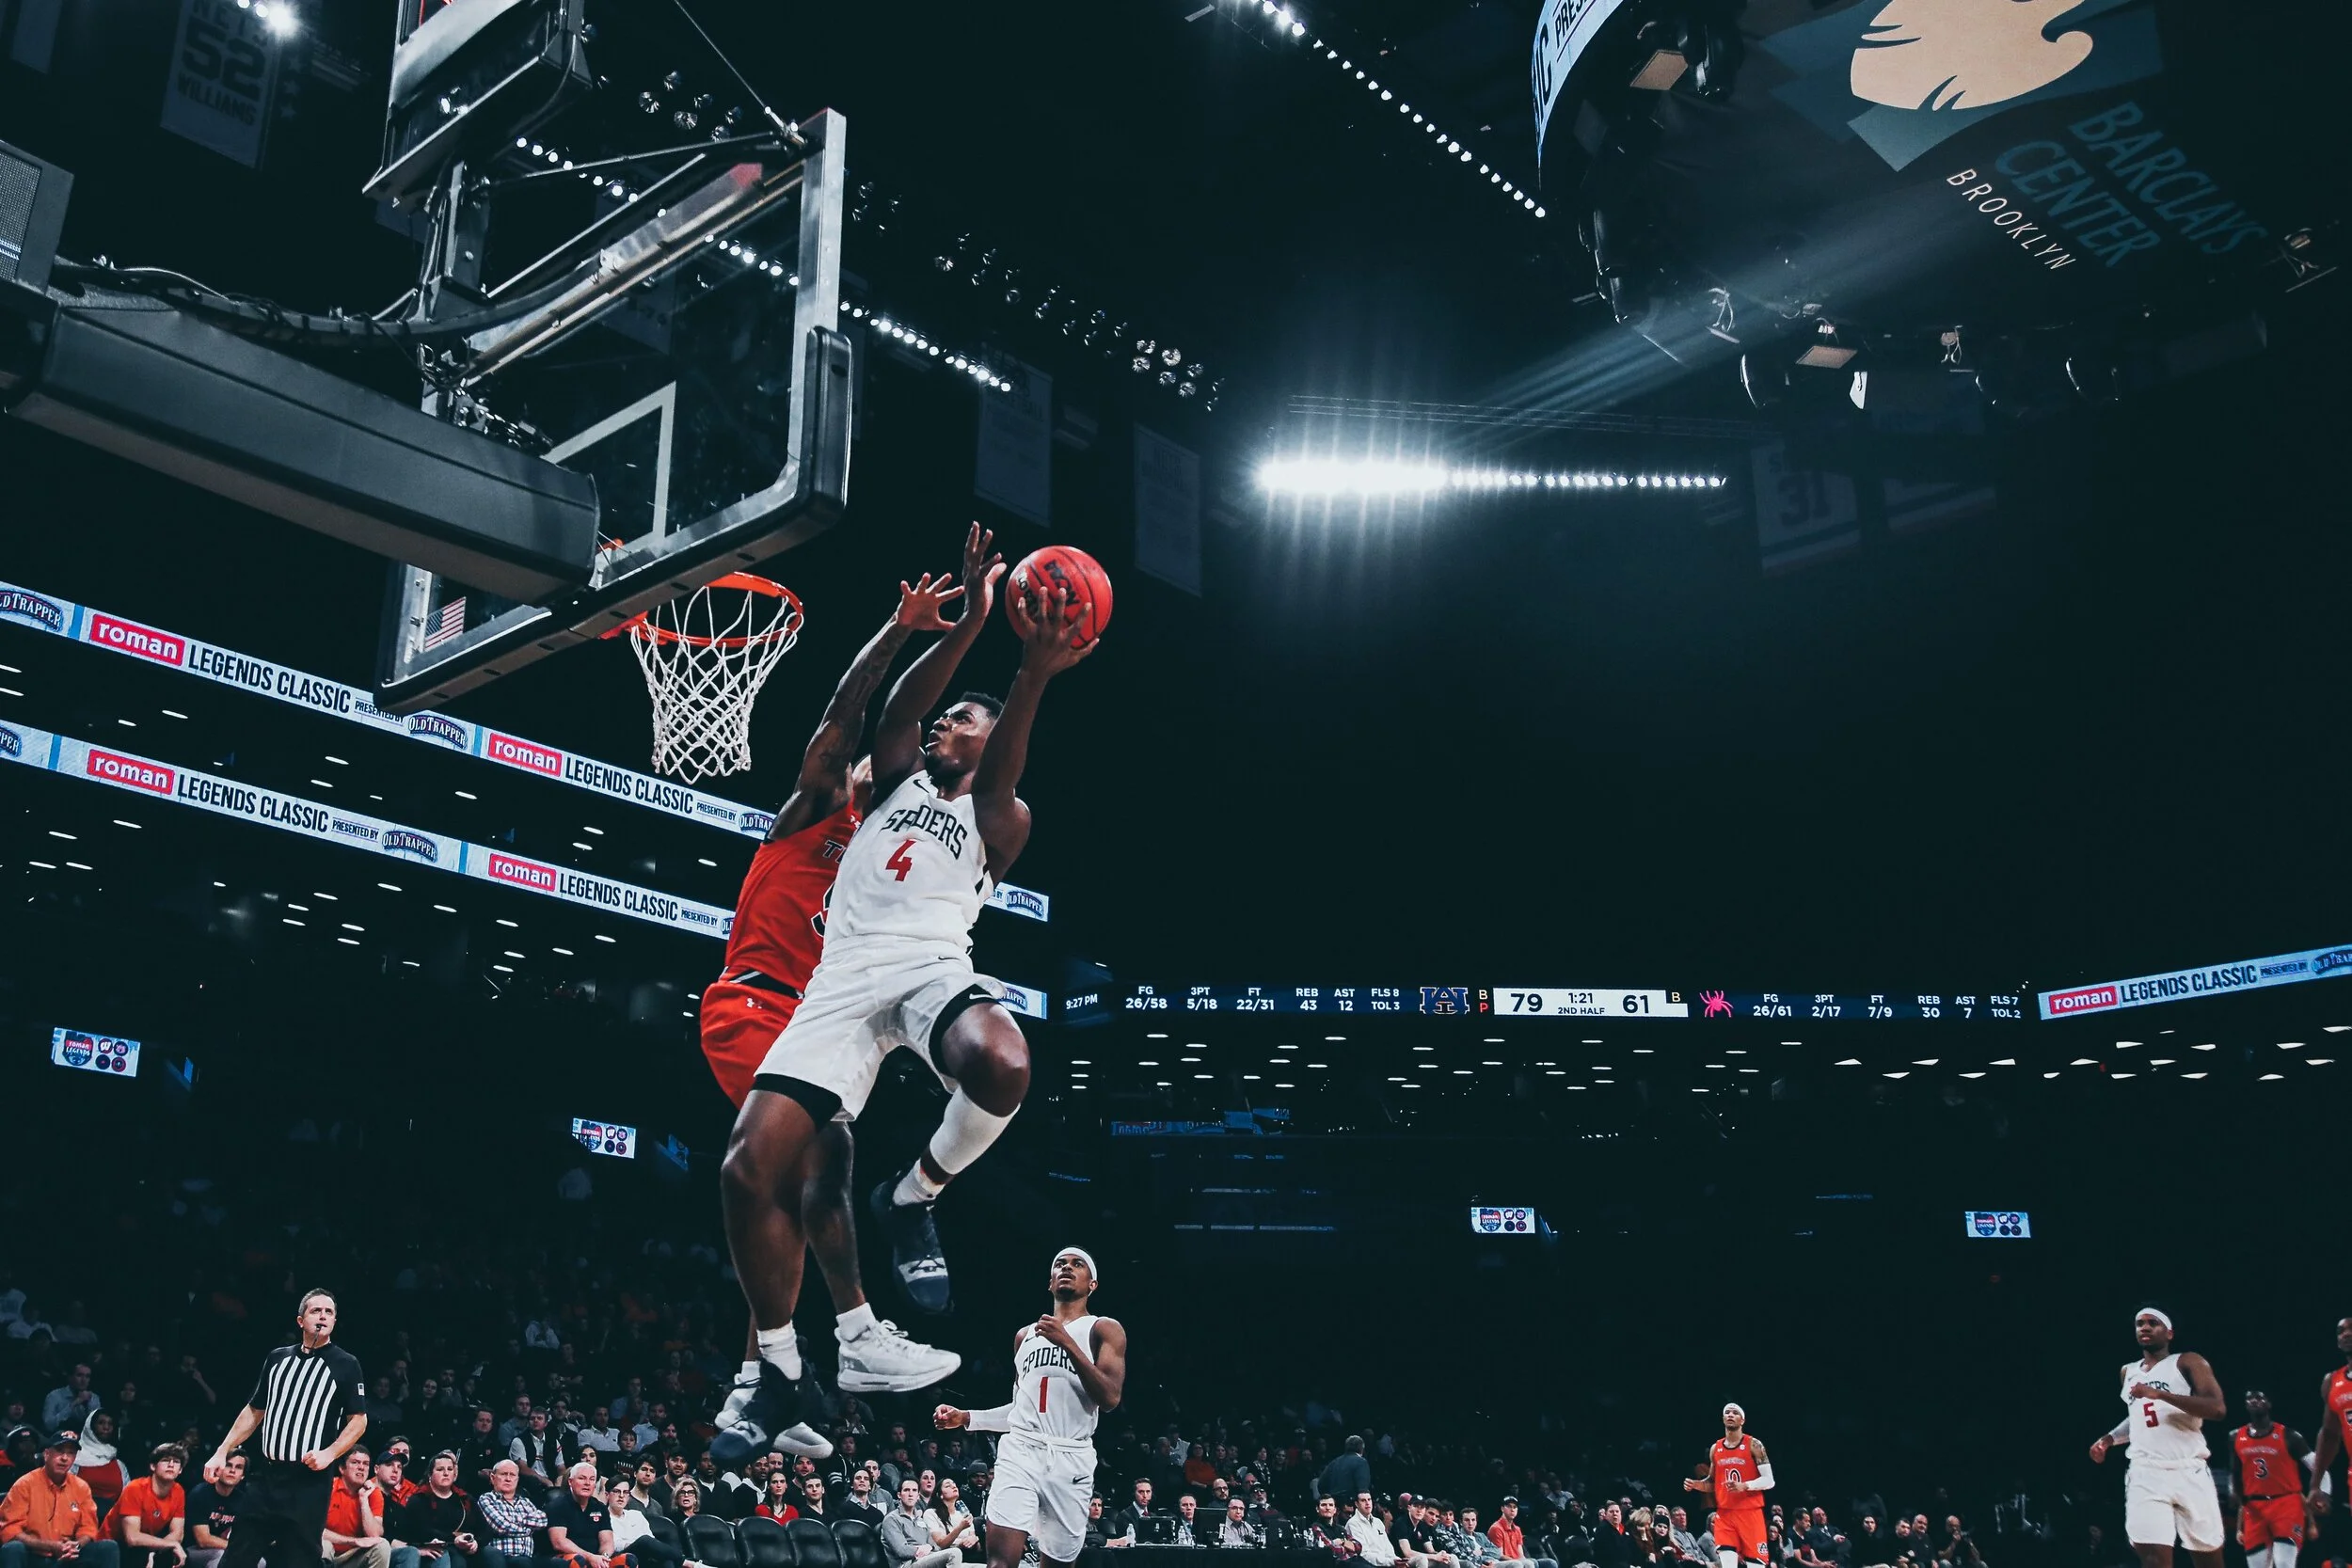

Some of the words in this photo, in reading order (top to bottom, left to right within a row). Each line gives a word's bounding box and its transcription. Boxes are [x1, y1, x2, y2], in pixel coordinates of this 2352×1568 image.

[182, 15, 265, 102] 52
[178, 71, 257, 126] WILLIAMS
[2069, 101, 2268, 255] BARCLAYS
[1994, 140, 2161, 268] CENTER
[1947, 168, 2076, 270] BROOKLYN
[12, 593, 61, 627] TRAPPER
[99, 622, 178, 659] roman
[188, 644, 274, 691] LEGENDS
[277, 671, 352, 713] CLASSIC
[408, 717, 426, 731] OLD
[426, 718, 467, 746] TRAPPER
[495, 740, 557, 771] roman
[95, 757, 167, 789] roman
[565, 756, 632, 797] LEGENDS
[635, 778, 693, 814] CLASSIC
[177, 773, 257, 815] LEGENDS
[260, 796, 329, 832] CLASSIC
[696, 802, 728, 819] PRESENTED
[728, 810, 736, 821] BY
[740, 816, 754, 828] OLD
[332, 819, 369, 837] PRESENTED
[370, 829, 378, 841] BY
[383, 832, 399, 847] OLD
[399, 832, 436, 858] TRAPPER
[885, 839, 916, 881] 4
[495, 860, 551, 886] roman
[559, 873, 621, 907] LEGENDS
[624, 892, 678, 921] CLASSIC
[1006, 894, 1017, 904] OLD
[1017, 893, 1042, 914] TRAPPER
[681, 910, 710, 925] PRESENTED
[711, 917, 718, 926] BY
[2121, 974, 2189, 1003] LEGENDS
[2192, 964, 2258, 992] CLASSIC
[1138, 986, 1153, 995] FG
[1191, 987, 1211, 996] 3PT
[1248, 988, 1262, 996] FT
[1295, 988, 1318, 997] REB
[1334, 989, 1355, 998] AST
[1372, 988, 1391, 997] FLS
[1392, 989, 1400, 997] 8
[1479, 990, 1488, 1000] B
[1672, 992, 1680, 1002] B
[1066, 997, 1083, 1009] 9:27
[1085, 994, 1098, 1006] PM
[1125, 997, 1168, 1010] 26/58
[1186, 998, 1217, 1010] 5/18
[1510, 992, 1543, 1013] 79
[1568, 992, 1594, 1004] 1:21
[1622, 994, 1650, 1014] 61
[1763, 993, 1779, 1003] FG
[1815, 994, 1834, 1004] 3PT
[1870, 994, 1883, 1004] FT
[1917, 995, 1941, 1005] REB
[1955, 995, 1976, 1005] AST
[1990, 995, 2010, 1005] FLS
[2011, 997, 2018, 1006] 7
[2053, 990, 2113, 1010] roman
[1236, 999, 1275, 1011] 22/31
[1300, 1000, 1317, 1011] 43
[1338, 1000, 1354, 1011] 12
[1371, 1001, 1391, 1010] TOL
[1393, 1002, 1400, 1010] 3
[1480, 1003, 1488, 1013] P
[1557, 1006, 1578, 1015] 2ND
[1581, 1006, 1605, 1015] HALF
[1753, 1006, 1792, 1017] 26/61
[1811, 1006, 1841, 1018] 2/17
[1867, 1006, 1893, 1018] 7/9
[1922, 1007, 1940, 1019] 30
[1963, 1007, 1972, 1019] 7
[1991, 1008, 2012, 1018] TOL
[2013, 1009, 2021, 1019] 2
[1039, 1376, 1048, 1414] 1
[2143, 1402, 2159, 1428] 5
[2253, 1458, 2269, 1481] 3
